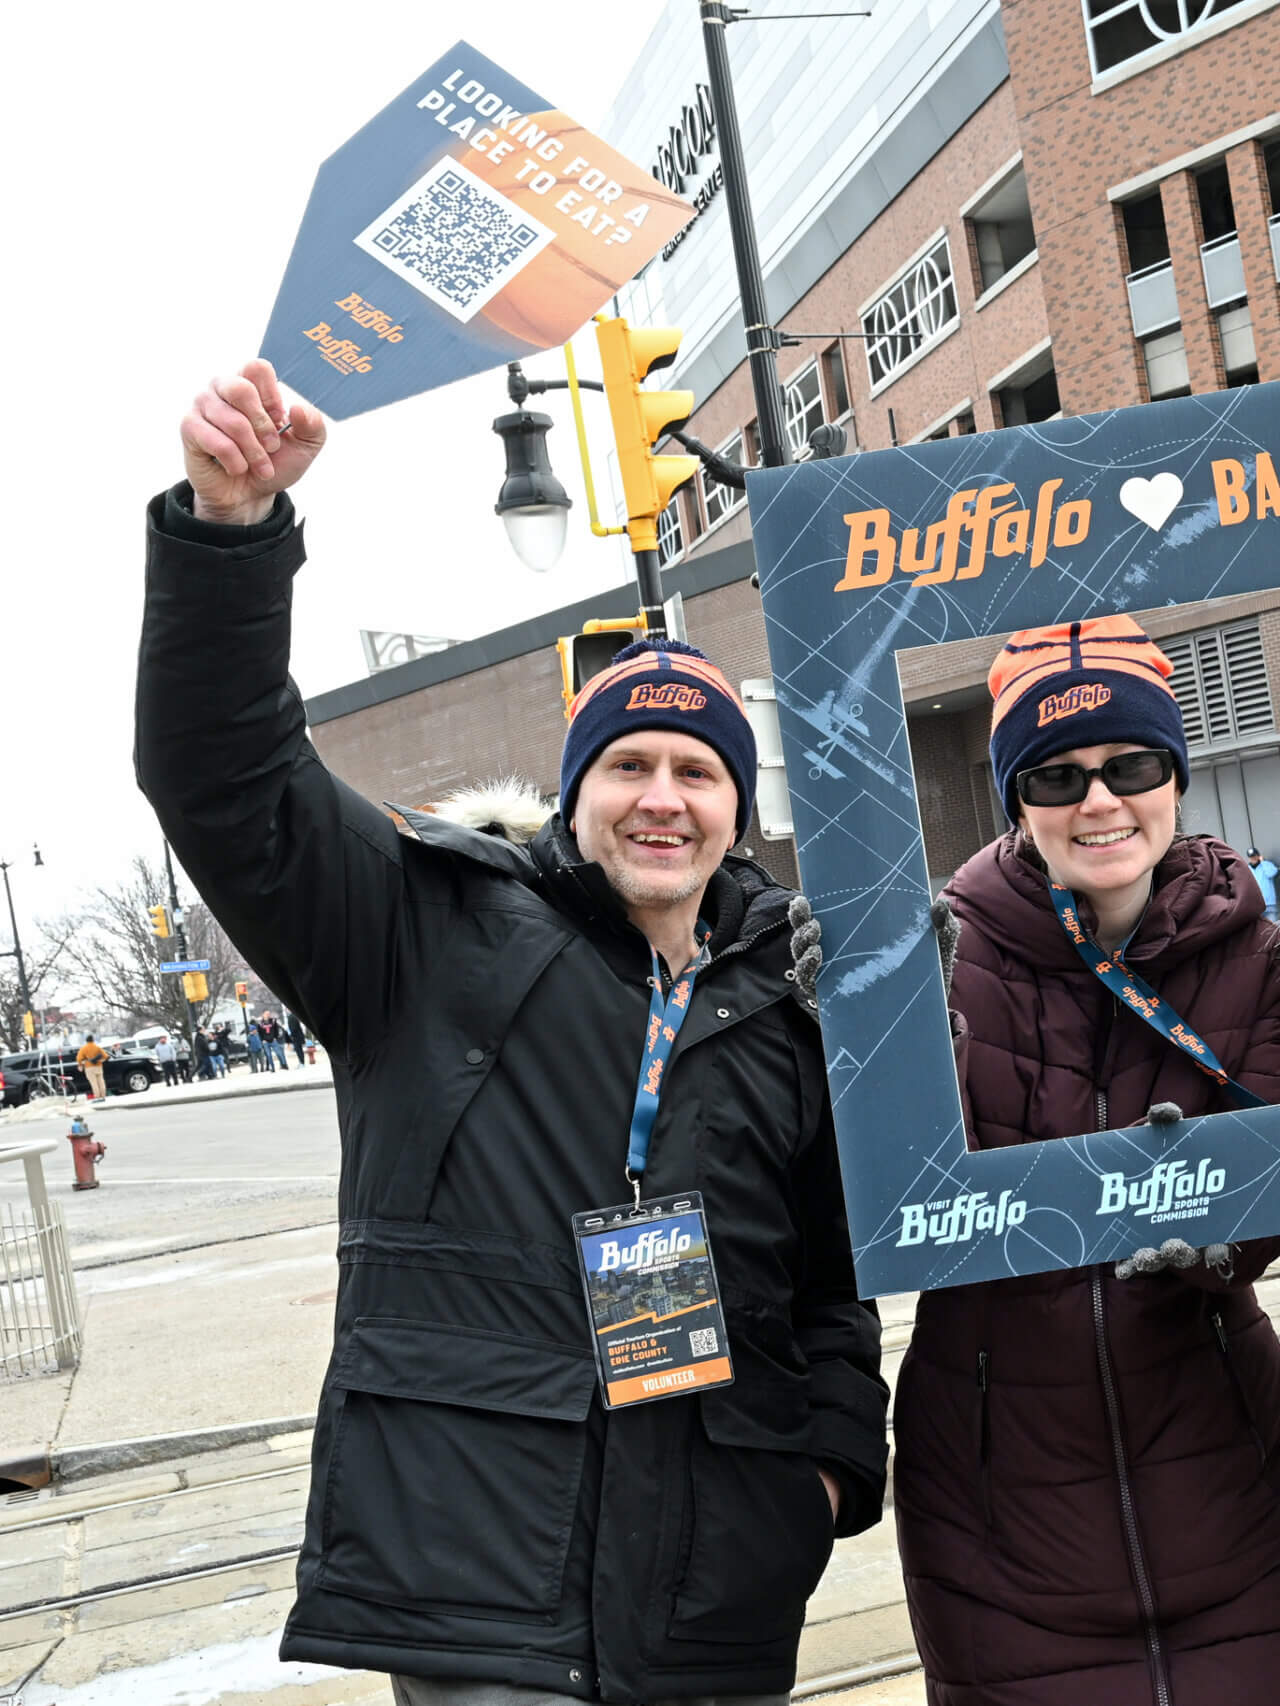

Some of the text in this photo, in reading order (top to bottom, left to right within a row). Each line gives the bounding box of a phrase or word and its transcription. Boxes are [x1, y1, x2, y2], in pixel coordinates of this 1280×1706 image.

[441, 69, 651, 228] LOOKING FOR A
[416, 89, 633, 247] PLACE TO EAT?
[334, 291, 405, 344] Buffalo
[301, 321, 374, 374] Buffalo
[834, 477, 1092, 593] Buffalo
[625, 683, 707, 711] Buffalo
[1037, 683, 1112, 728] Buffalo
[1062, 907, 1087, 944] Buffalo
[1122, 986, 1155, 1018] Buffalo
[1170, 1023, 1205, 1055] Buffalo
[927, 1198, 951, 1212] VISIT
[1096, 1158, 1226, 1216] Buffalo
[1174, 1196, 1210, 1209] SPORTS
[895, 1190, 1027, 1247] Buffalo
[1150, 1206, 1209, 1224] COMMISSION
[598, 1227, 692, 1272] Buffalo
[608, 1340, 648, 1356] BUFFALO
[610, 1355, 631, 1366] ERIE
[633, 1346, 668, 1361] COUNTY
[642, 1369, 696, 1393] VOLUNTEER
